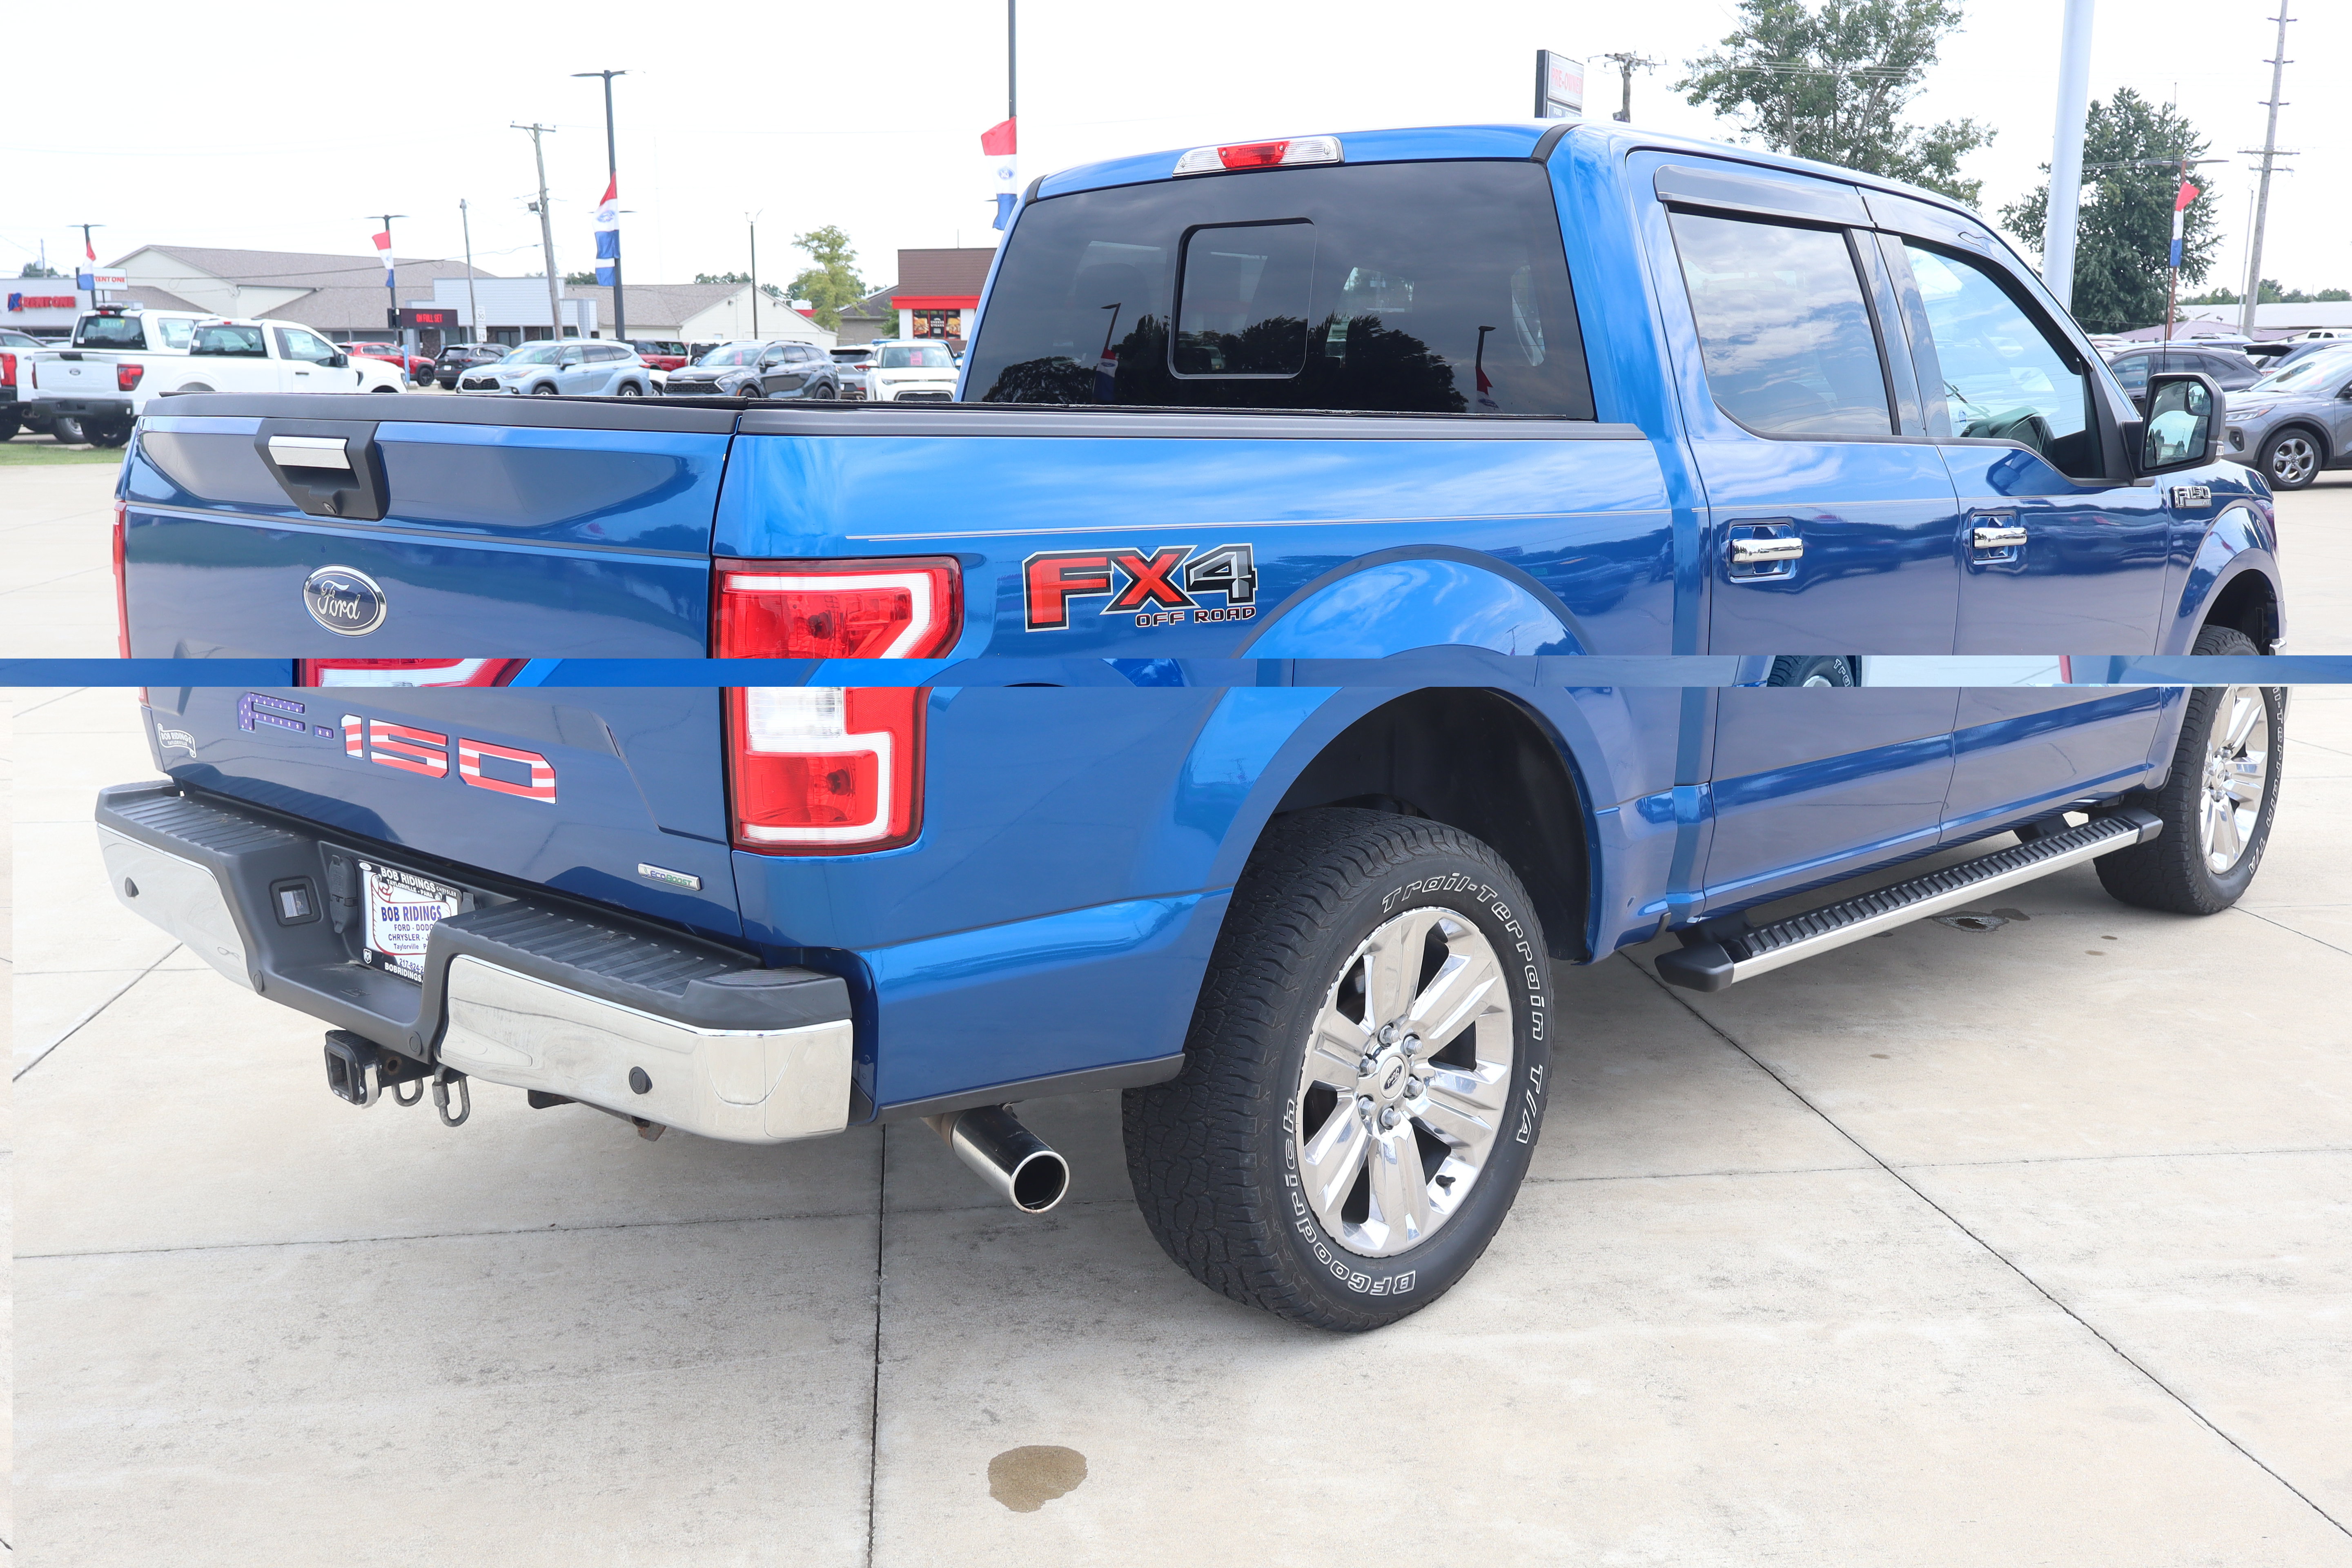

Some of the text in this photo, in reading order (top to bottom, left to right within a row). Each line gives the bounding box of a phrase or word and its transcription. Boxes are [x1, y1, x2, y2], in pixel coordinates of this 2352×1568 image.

[23, 296, 76, 308] RENT ONE
[416, 314, 443, 323] ON FULL SET
[1022, 543, 1258, 632] FX4
[317, 579, 361, 620] Ford
[1136, 606, 1256, 628] OFF ROAD
[171, 732, 192, 744] RIDINGS
[238, 692, 557, 804] F-150
[381, 867, 436, 892] BOB RIDINGS
[386, 879, 417, 893] TAYLORVILLE
[650, 871, 692, 886] ECOBOOST
[436, 886, 457, 897] CHRYSLER
[381, 905, 441, 921] BOB RIDINGS
[1382, 873, 1544, 1144] Trail-Terrain T/A
[1387, 1067, 1399, 1087] Ford
[1283, 1098, 1416, 1296] BFGoodrich
